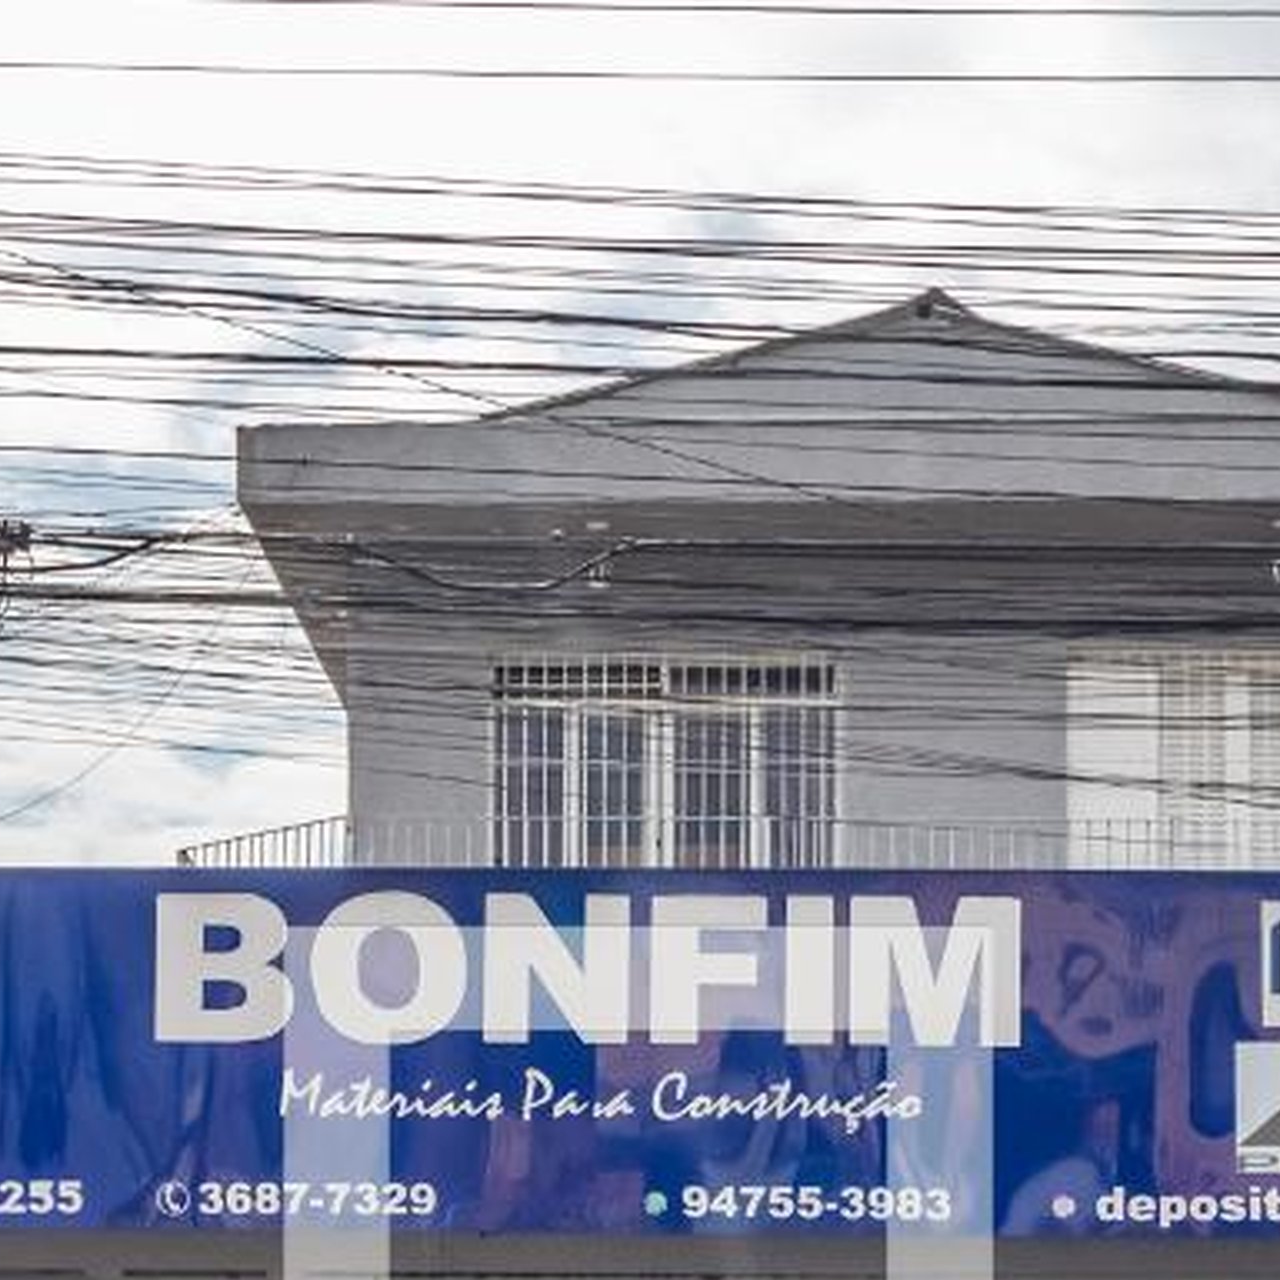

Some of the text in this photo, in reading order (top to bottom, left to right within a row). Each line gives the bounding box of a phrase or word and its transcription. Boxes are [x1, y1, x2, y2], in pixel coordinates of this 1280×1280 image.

[154, 890, 1022, 1047] BONFIM
[279, 1067, 504, 1119] Materiais
[652, 1070, 927, 1134] Construção
[198, 1182, 438, 1217] 3687-7329
[682, 1186, 952, 1222] 94755-3983
